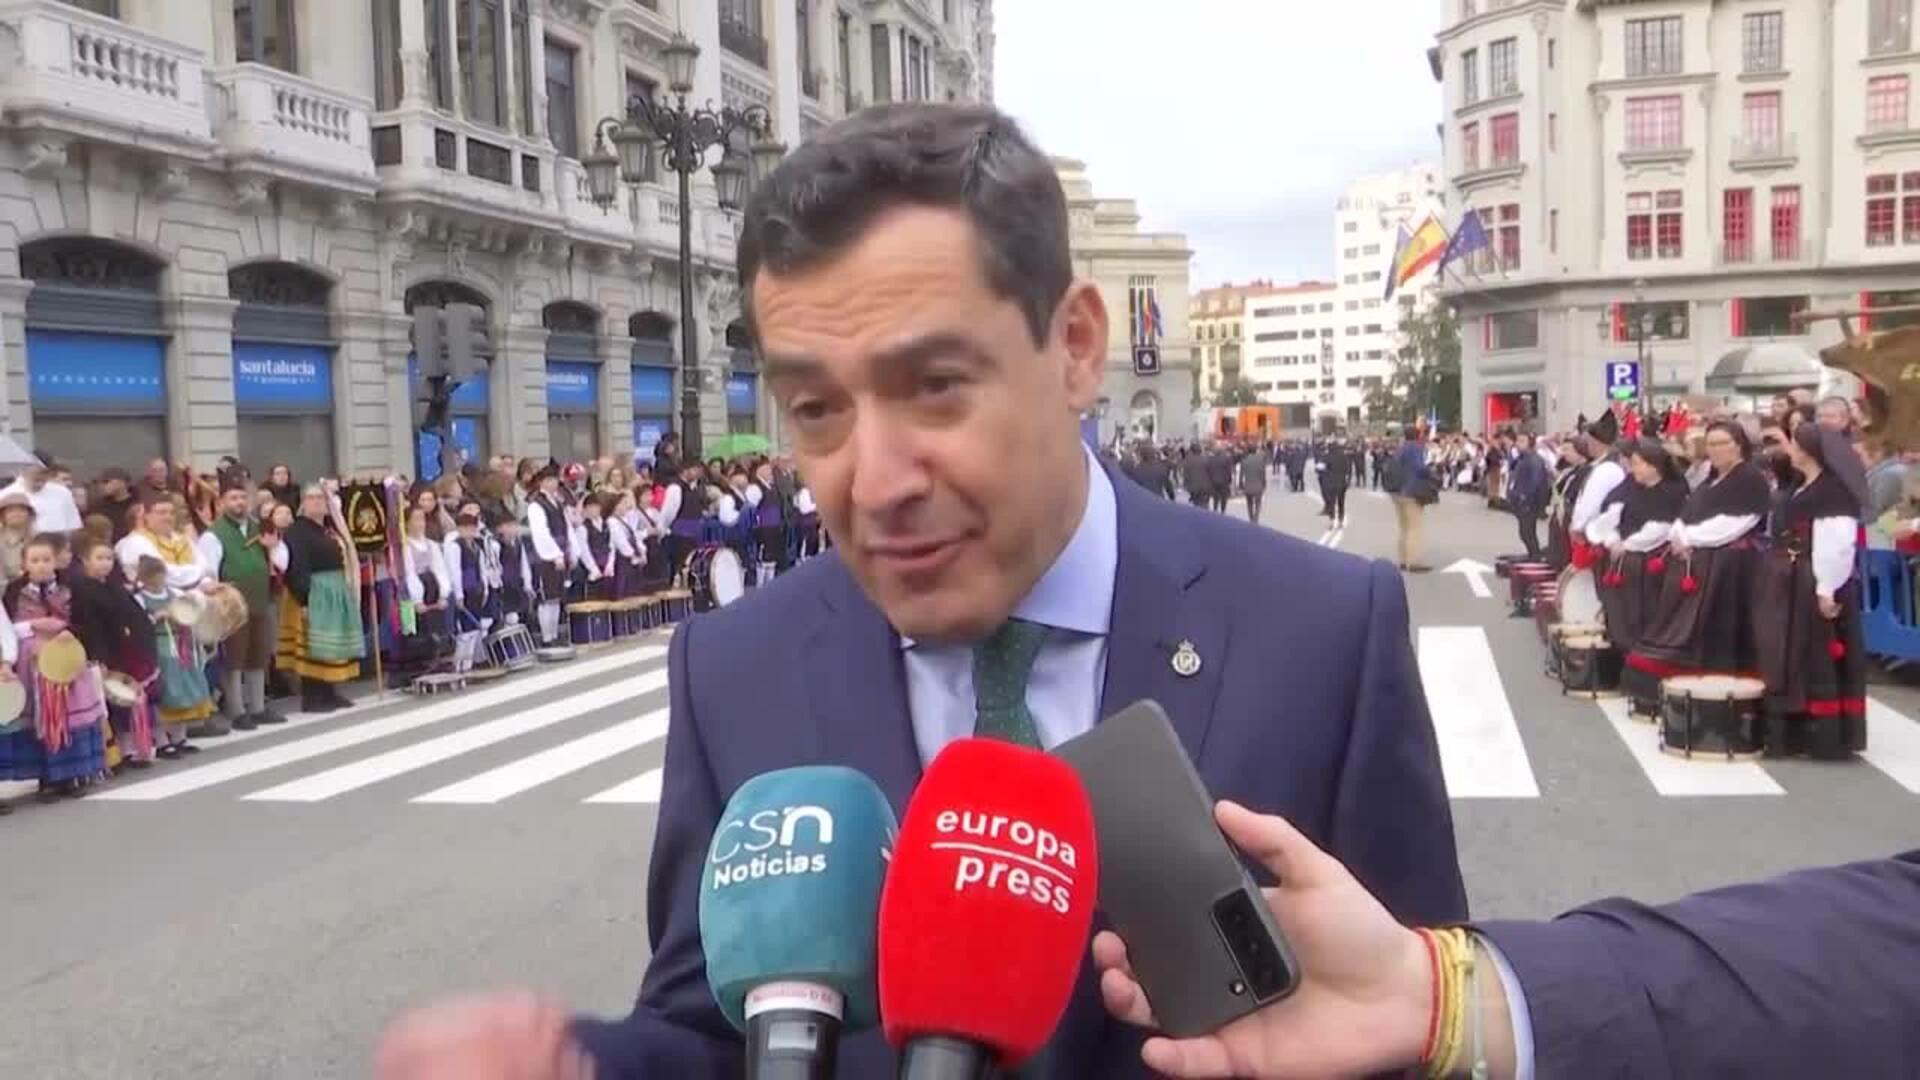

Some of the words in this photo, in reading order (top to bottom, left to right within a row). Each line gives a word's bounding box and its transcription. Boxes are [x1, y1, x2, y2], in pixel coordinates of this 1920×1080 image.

[935, 810, 1077, 869] europa
[713, 850, 828, 890] Noticias
[954, 855, 1071, 914] press
